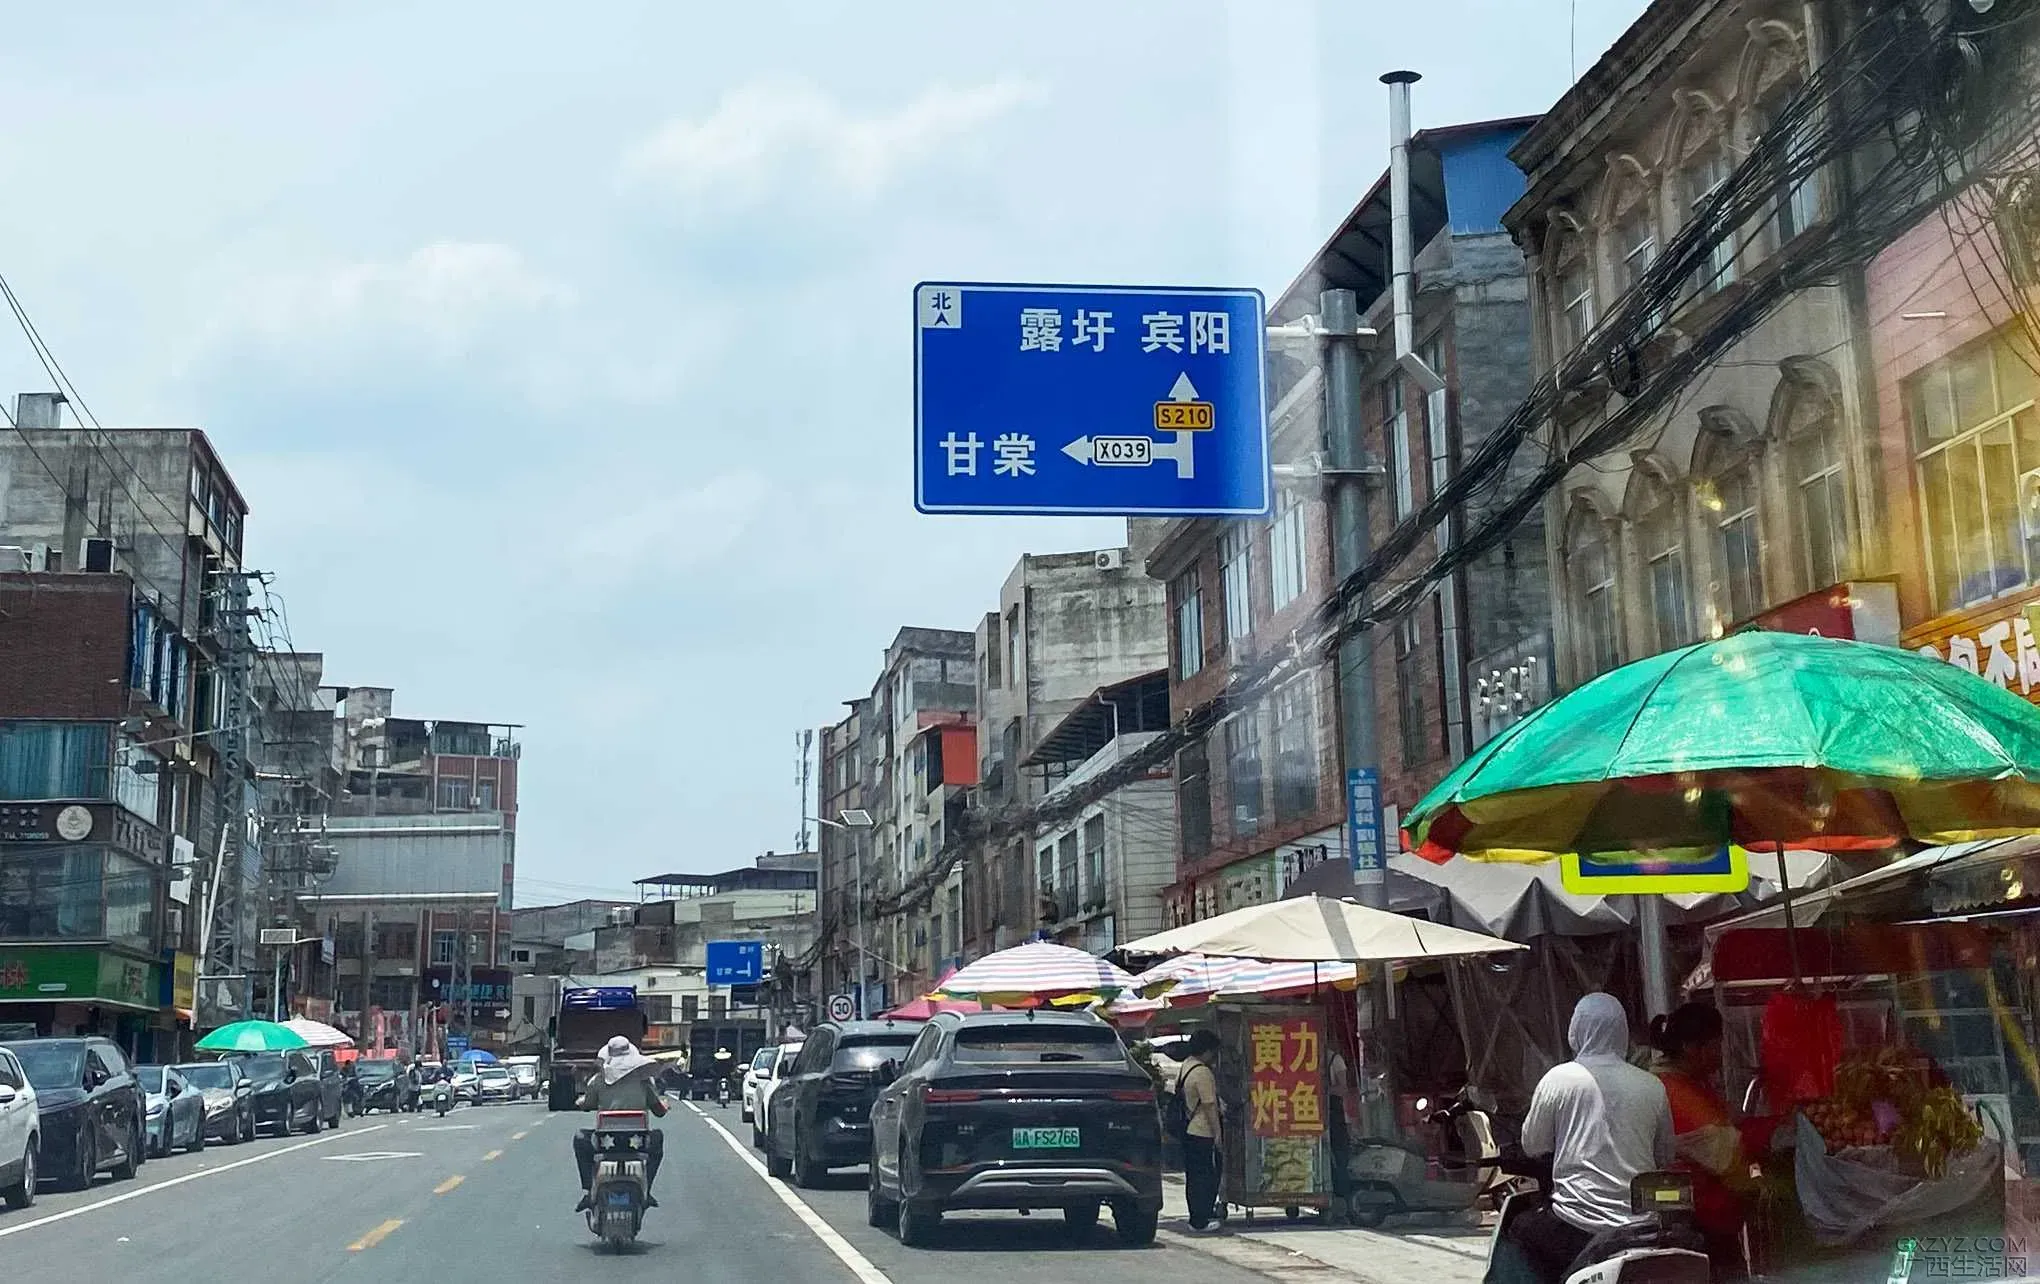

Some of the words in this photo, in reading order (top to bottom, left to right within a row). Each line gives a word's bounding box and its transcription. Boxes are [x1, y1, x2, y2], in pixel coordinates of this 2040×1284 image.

[931, 292, 952, 310] 北
[1019, 308, 1116, 353] 露圩
[1141, 311, 1231, 355] 宾阳
[1160, 408, 1209, 425] S210
[939, 431, 1038, 477] 甘棠
[1099, 441, 1147, 459] X039
[835, 1002, 849, 1015] 30
[1251, 1022, 1320, 1074] 黄力
[1251, 1080, 1324, 1133] 炸鱼
